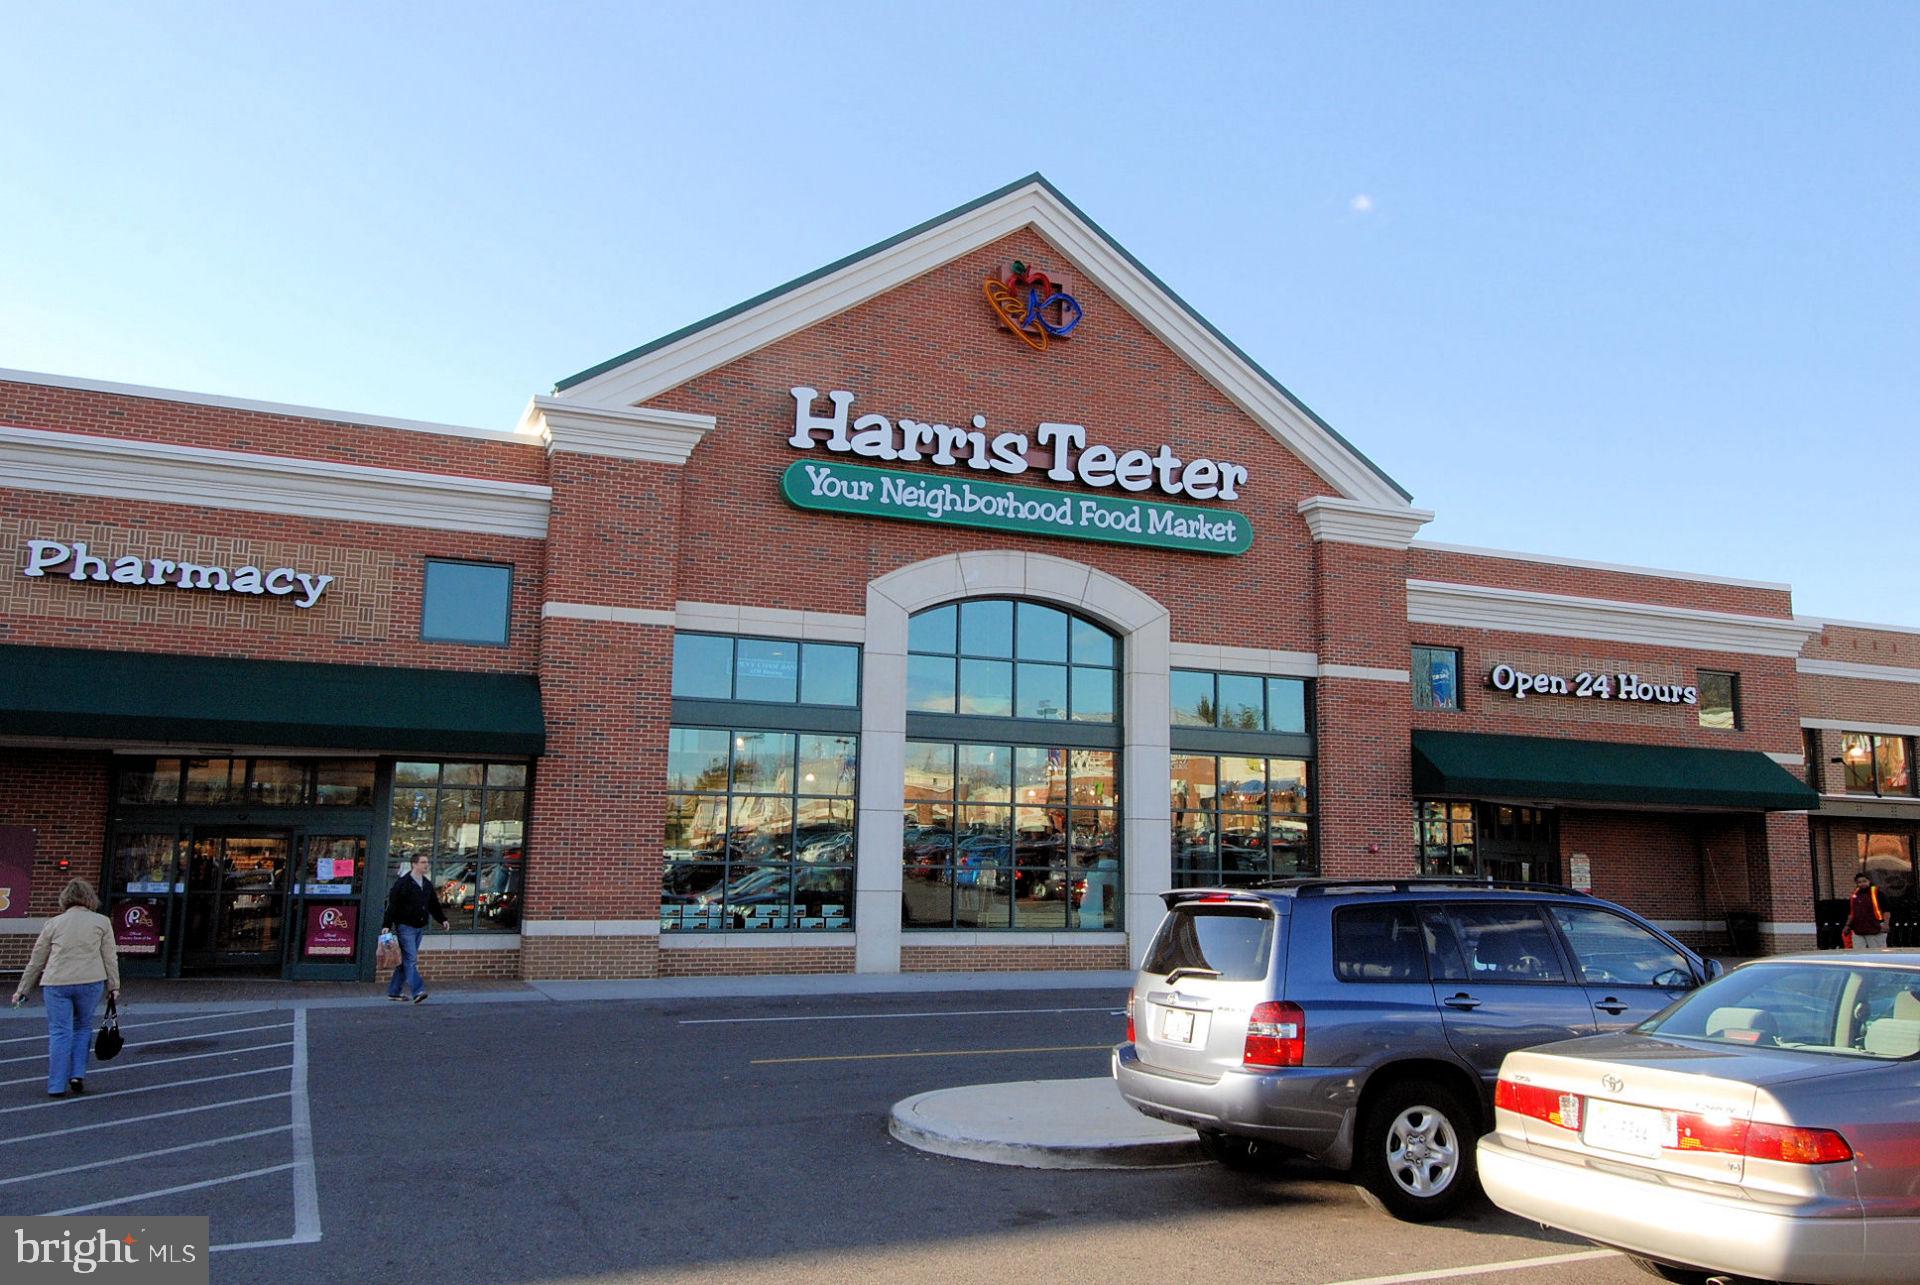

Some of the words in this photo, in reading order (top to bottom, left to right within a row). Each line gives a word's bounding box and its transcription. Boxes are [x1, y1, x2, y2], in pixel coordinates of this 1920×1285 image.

[788, 386, 1029, 475] Harris
[1036, 421, 1249, 501] Teeter
[804, 465, 875, 502] Your
[881, 476, 1073, 527] Neighborhood
[1078, 500, 1142, 535] Food
[1147, 508, 1237, 543] Market
[23, 539, 334, 609] Pharmacy
[1491, 663, 1570, 699] Open
[1574, 671, 1611, 699] 24
[1616, 673, 1697, 705] Hours
